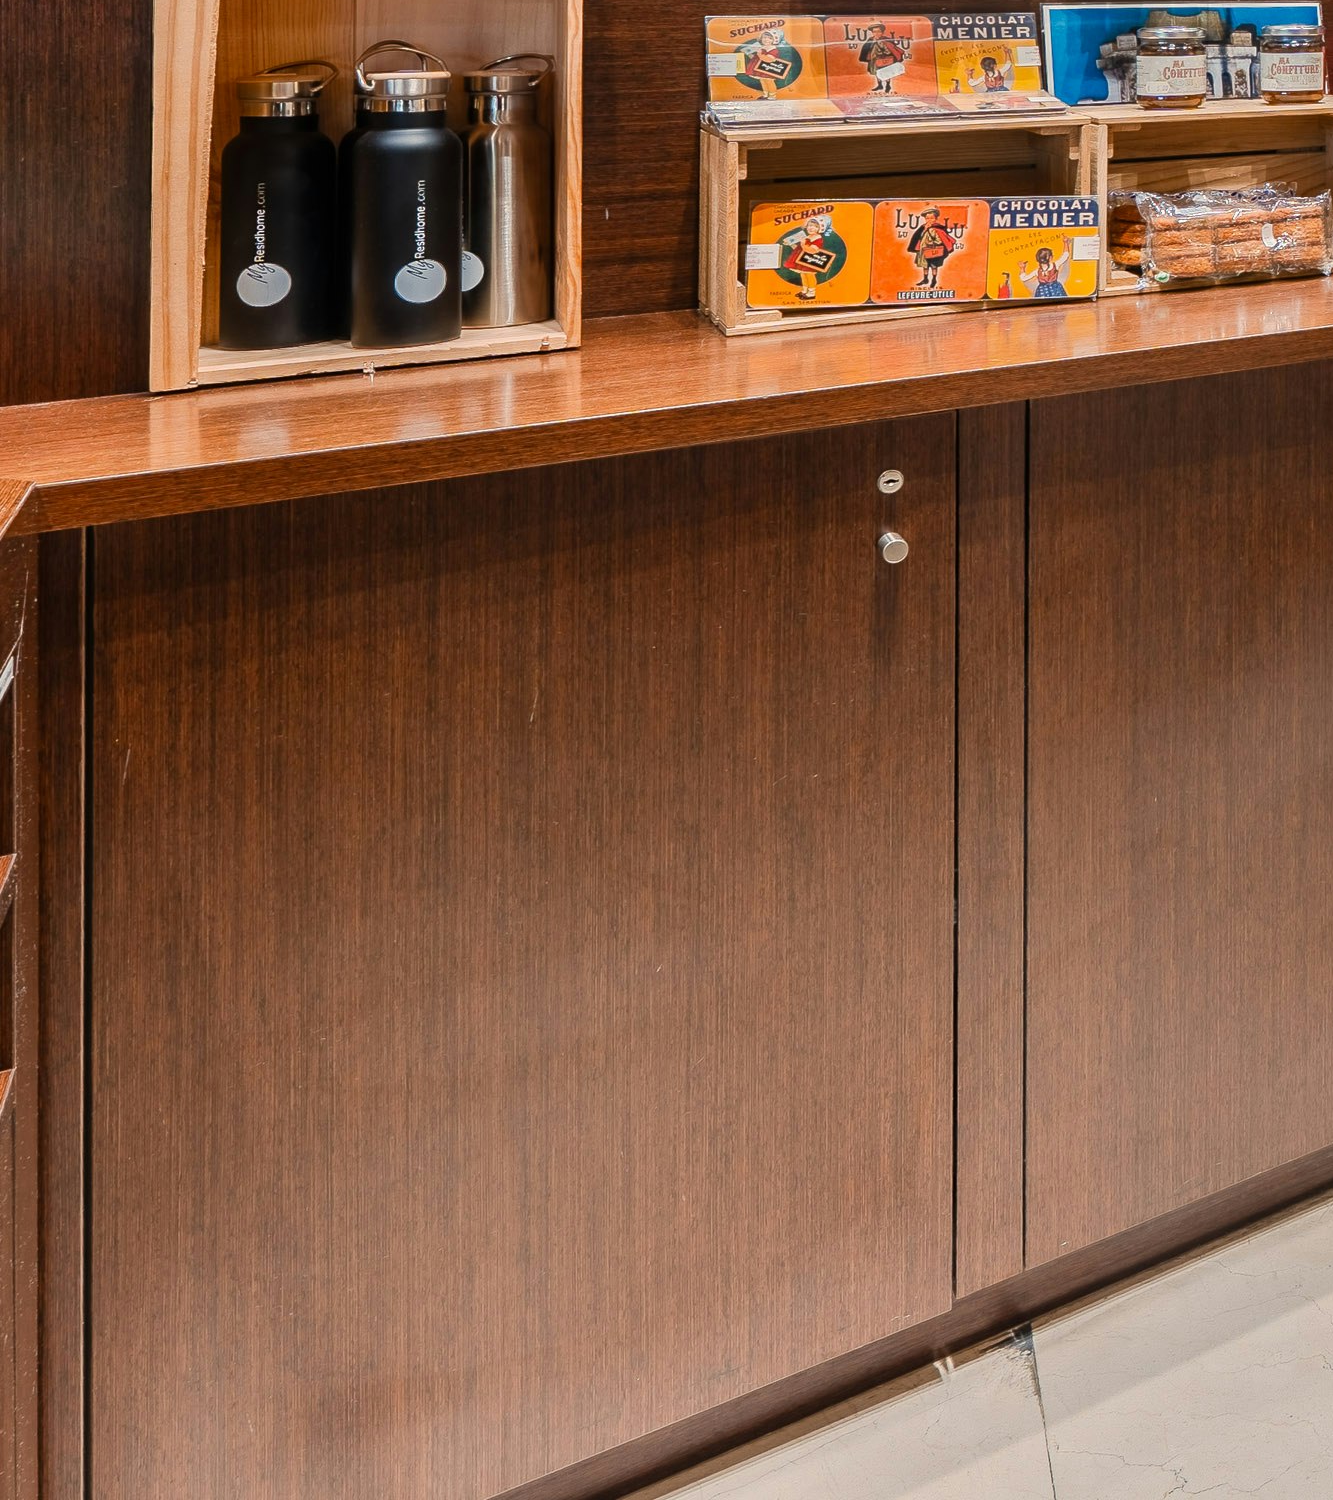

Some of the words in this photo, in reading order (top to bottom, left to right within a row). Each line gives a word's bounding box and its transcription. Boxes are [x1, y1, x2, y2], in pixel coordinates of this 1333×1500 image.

[939, 15, 1027, 26] CHOCOLAT
[729, 19, 785, 38] SUCHARD
[843, 24, 868, 42] LU
[937, 25, 1032, 40] MENIER
[1172, 60, 1185, 69] MA
[1279, 57, 1290, 66] MA
[1271, 64, 1321, 76] CONFITURE
[998, 200, 1094, 213] CHOCOLAT
[774, 205, 836, 226] SUCHARD
[895, 208, 920, 230] LU
[993, 211, 1096, 229] MENIER
